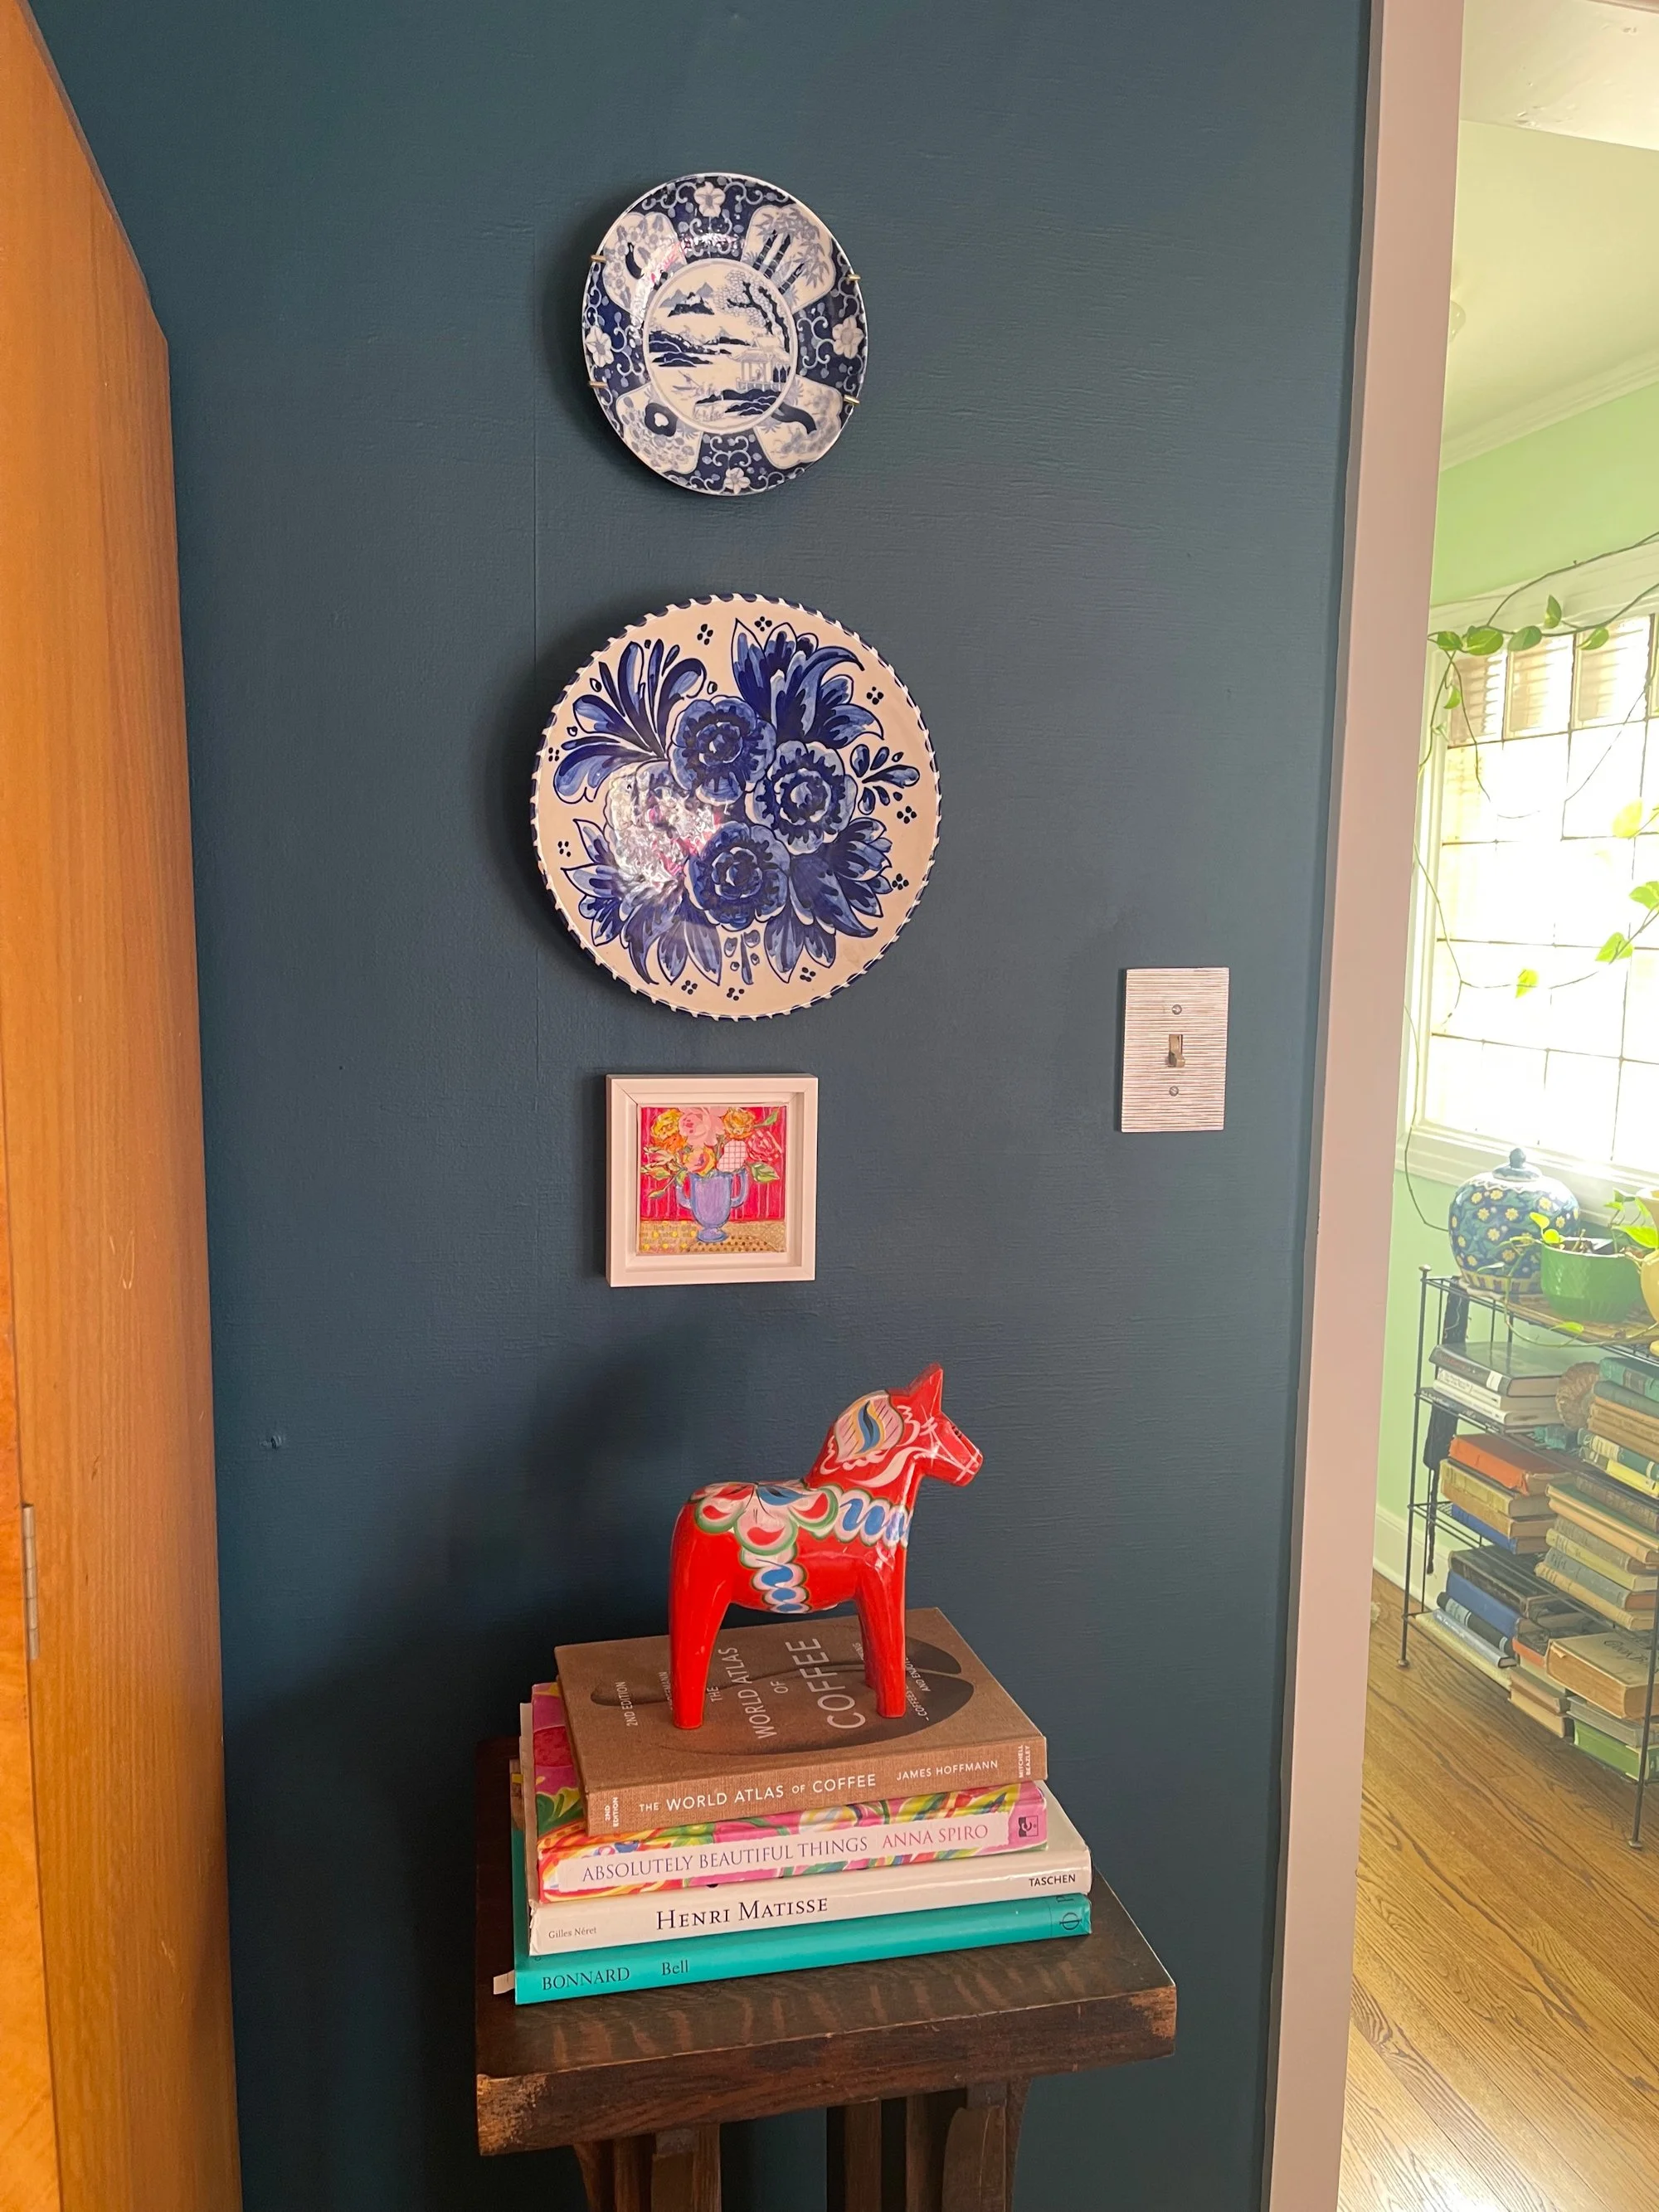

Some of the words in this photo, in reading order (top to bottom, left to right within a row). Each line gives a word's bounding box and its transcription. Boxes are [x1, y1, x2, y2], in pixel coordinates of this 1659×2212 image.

[718, 1647, 753, 1685] ATLAS
[615, 1681, 634, 1711] EDITION
[706, 1686, 723, 1703] THE
[770, 1680, 789, 1694] OF
[785, 1638, 866, 1729] COFFEE
[915, 1679, 932, 1692] AND
[623, 1710, 638, 1727] 2ND
[737, 1689, 777, 1739] WORLD
[896, 1767, 932, 1781] JAMES
[936, 1760, 998, 1776] HOFFMANN
[639, 1802, 659, 1812] THE
[666, 1792, 727, 1811] WORLD
[734, 1785, 784, 1803] ATLAS
[791, 1784, 805, 1794] OF
[812, 1773, 876, 1793] COFFEE
[582, 1855, 693, 1882] ABSOLUTELY
[699, 1844, 793, 1869] BEAUTIFUL
[797, 1836, 868, 1858] THINGS
[882, 1830, 933, 1849] ANNA
[937, 1825, 989, 1843] SPIRO
[1029, 1874, 1076, 1887] TASCHEN
[656, 1908, 731, 1930] HENRI
[737, 1898, 829, 1921] MATISSE
[548, 1928, 573, 1939] Gilles
[574, 1926, 596, 1937] Néret
[542, 1966, 630, 1991] BONNARD
[661, 1959, 689, 1976] Bell
